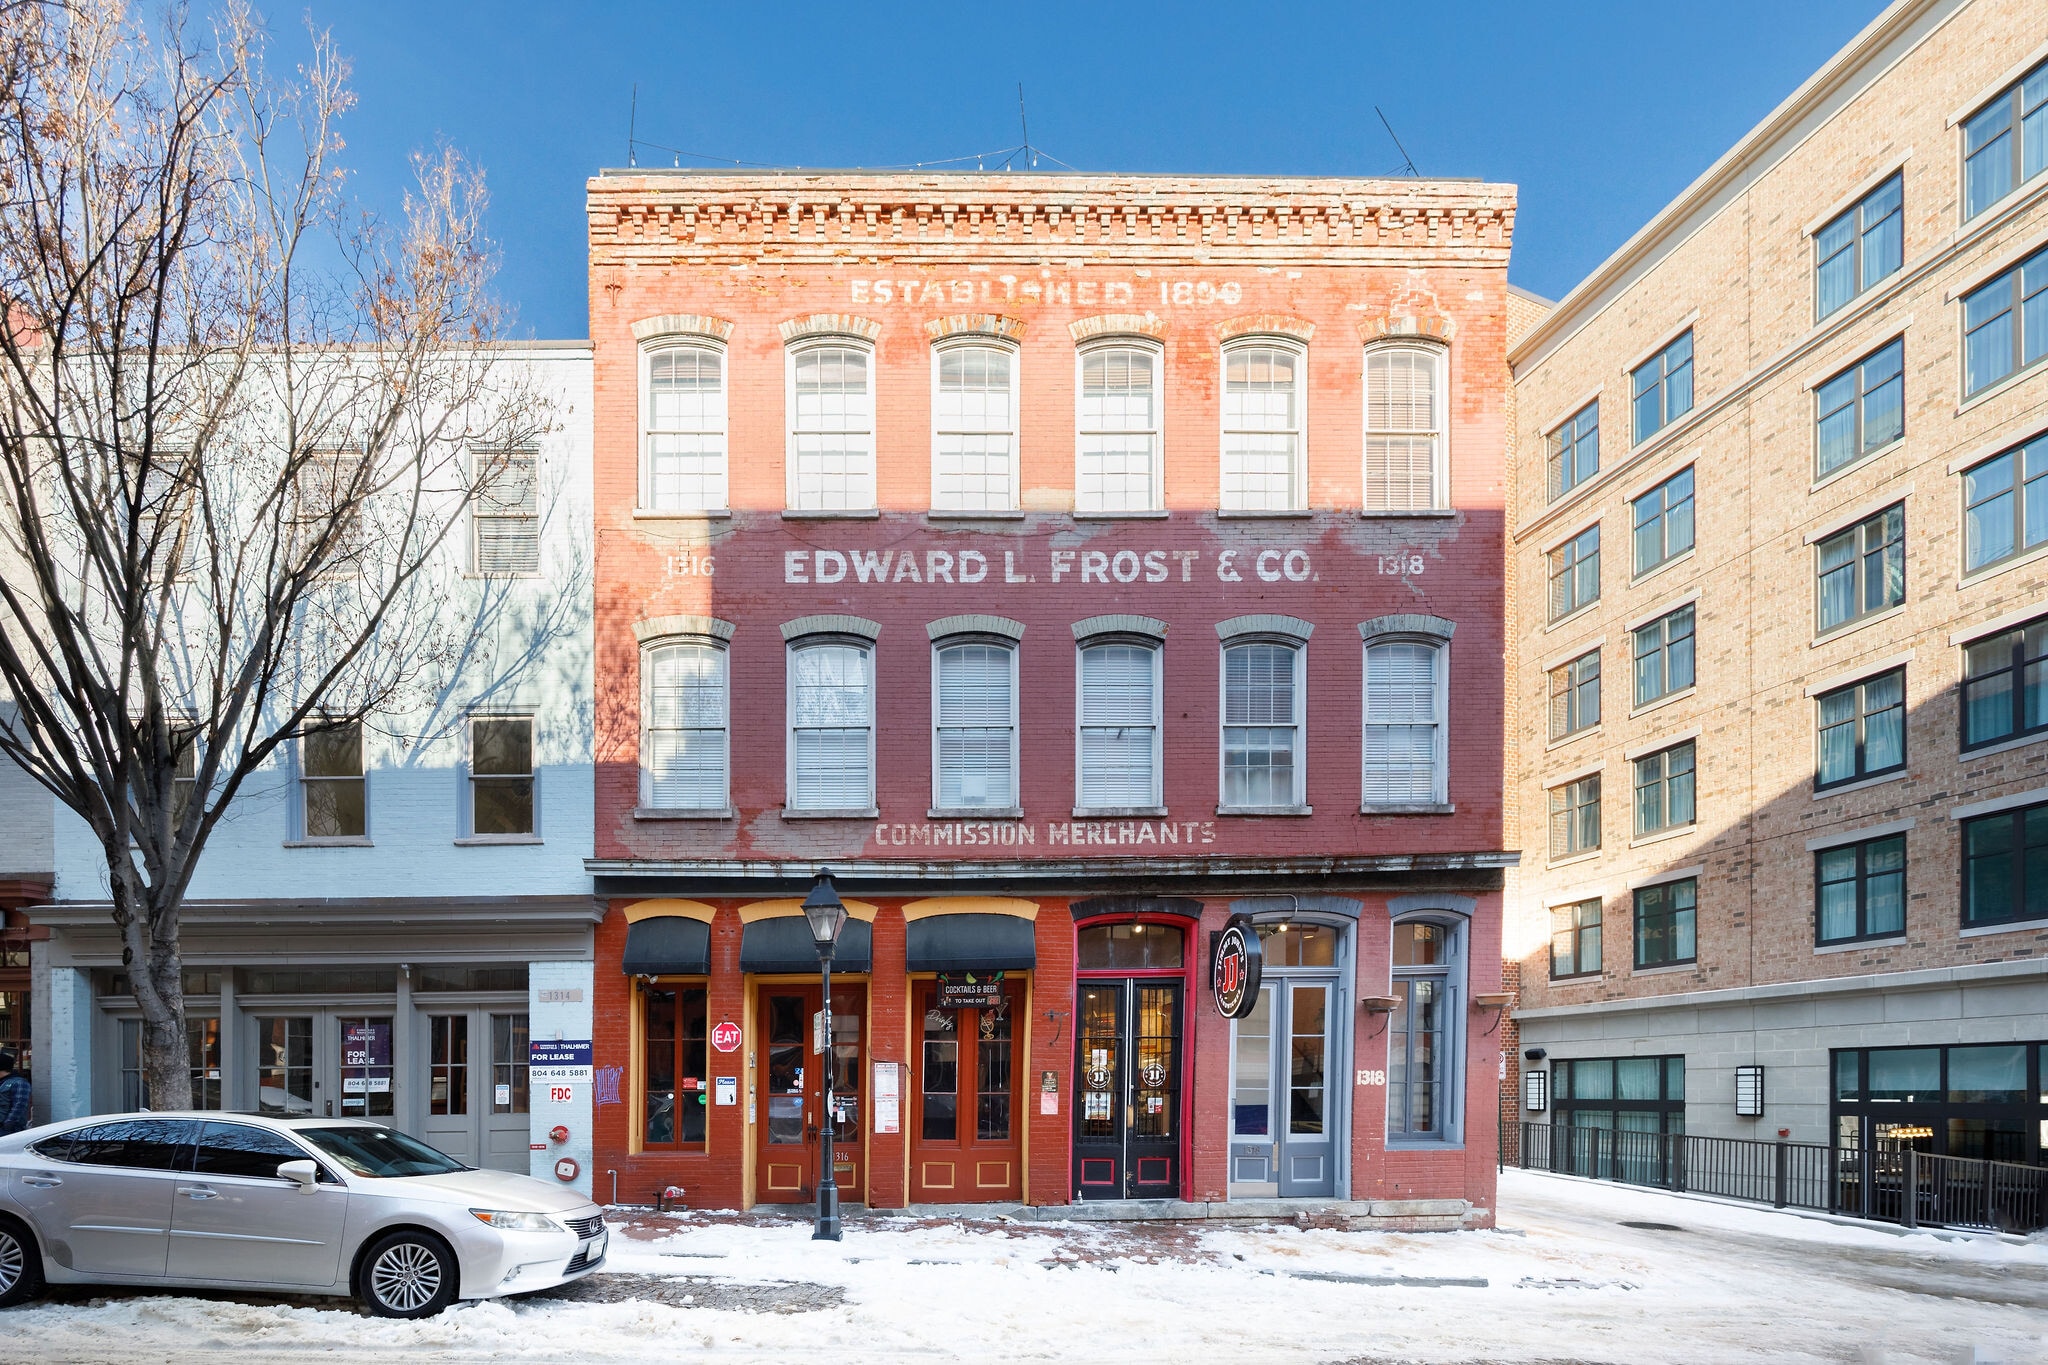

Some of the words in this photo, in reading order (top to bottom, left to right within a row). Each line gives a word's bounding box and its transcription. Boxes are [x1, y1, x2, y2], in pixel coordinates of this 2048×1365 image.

[667, 556, 716, 577] 1316
[784, 550, 989, 583] EDWARD
[1004, 550, 1036, 583] L.
[1051, 550, 1200, 583] FROST
[1216, 549, 1243, 583] &
[1255, 549, 1320, 582] CO.
[1378, 555, 1425, 576] 1318
[875, 823, 1035, 846] COMMISSION
[1049, 821, 1216, 845] MERCHANTS
[1222, 952, 1239, 993] JJ
[549, 991, 570, 1001] 1314
[945, 985, 976, 994] COCKTAILS
[982, 985, 998, 993] BEER
[715, 1030, 739, 1044] EAT
[347, 1050, 366, 1058] FOR
[531, 1053, 548, 1061] FOR
[347, 1057, 376, 1065] LEAE
[531, 1069, 547, 1077] 804
[550, 1069, 566, 1077] 648
[569, 1069, 588, 1077] 5881
[1356, 1069, 1386, 1086] 1318
[551, 1087, 572, 1100] FDC
